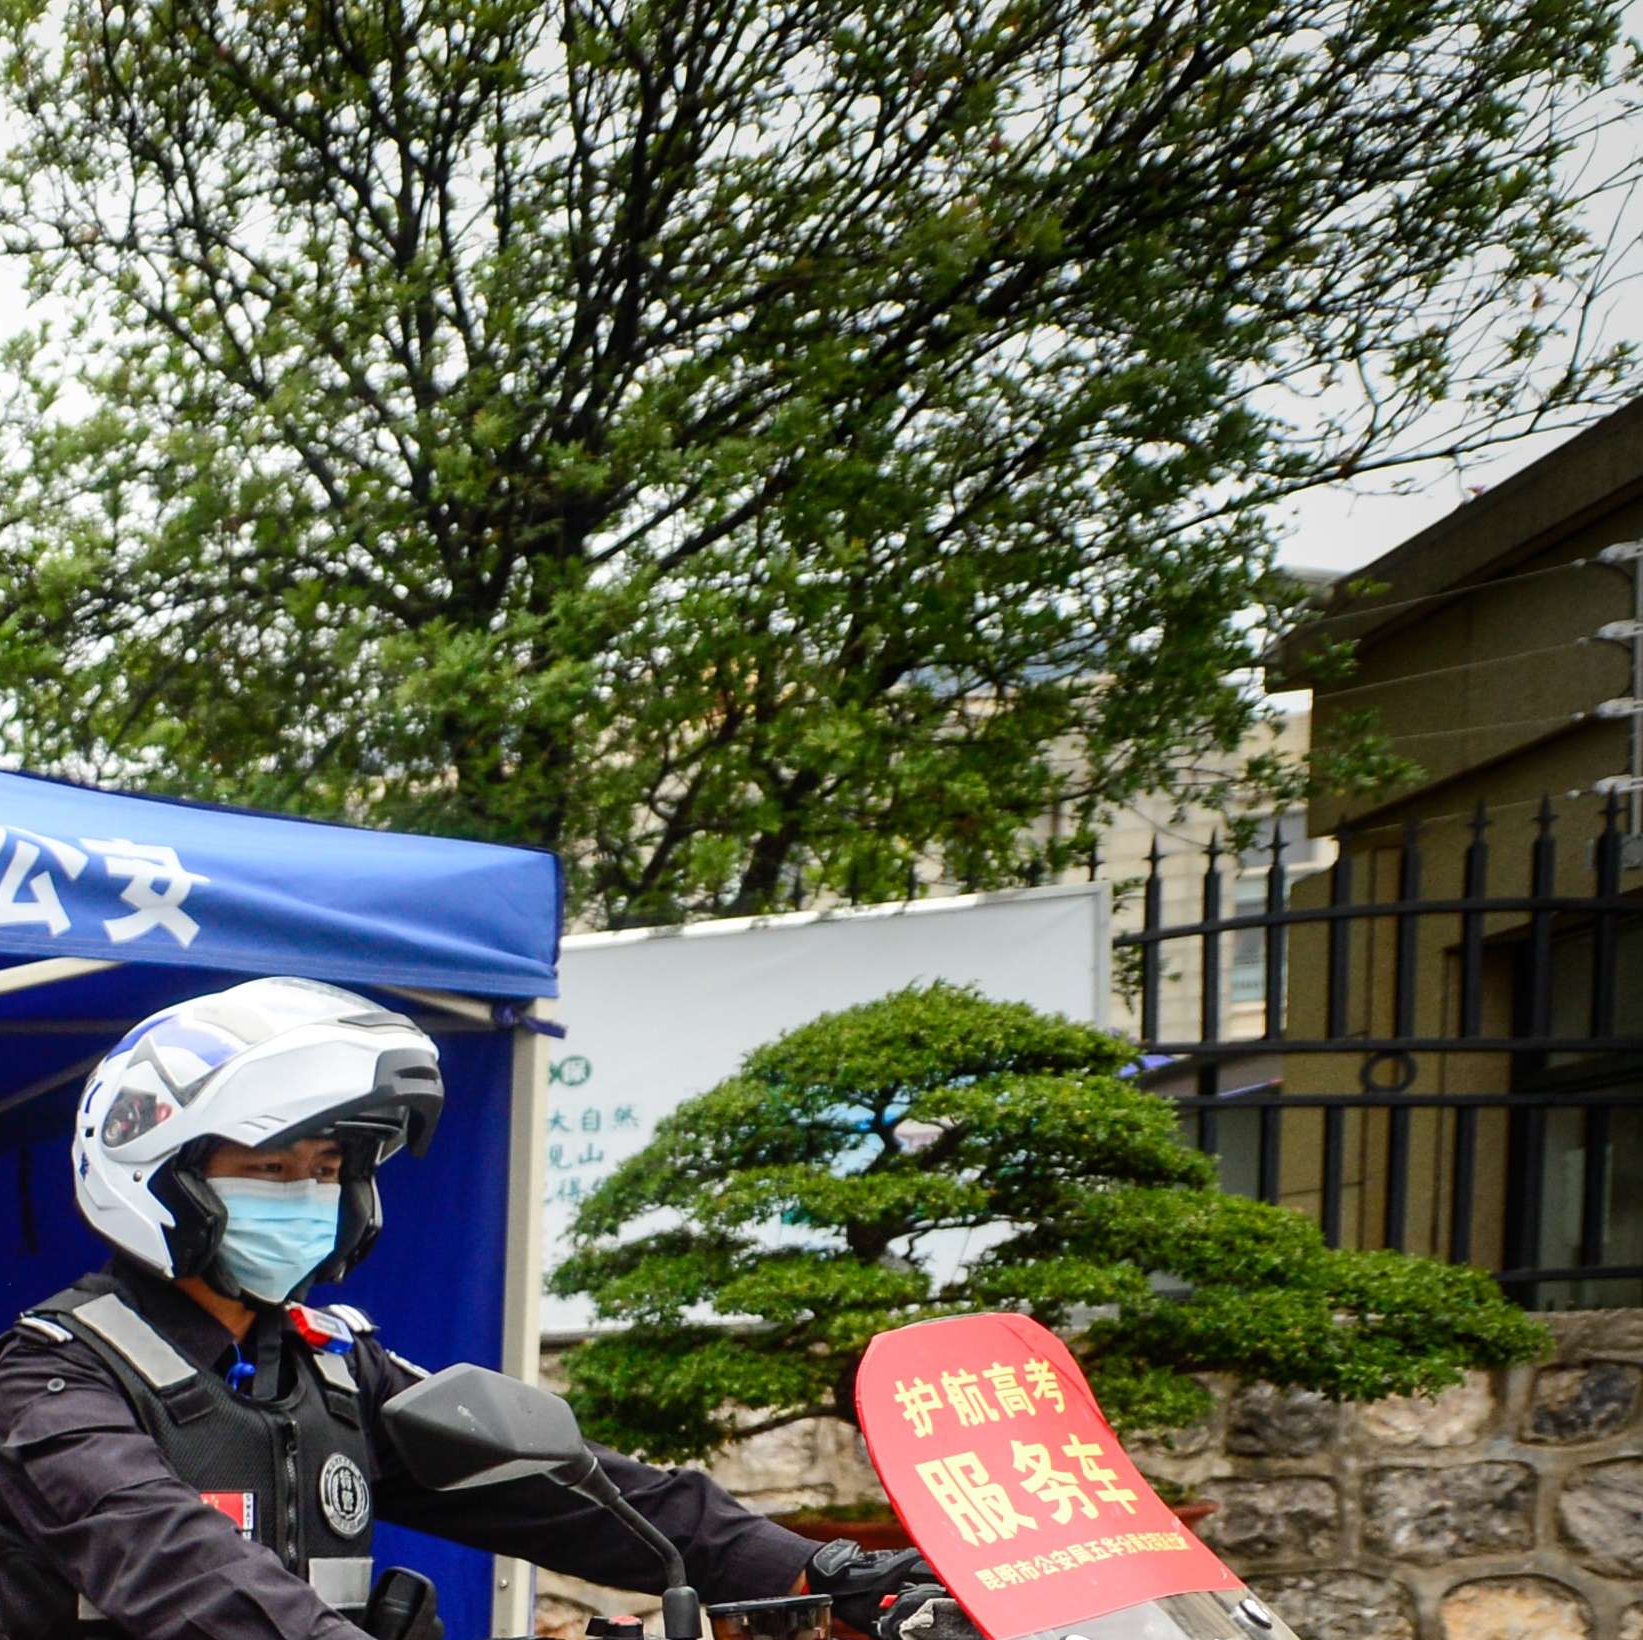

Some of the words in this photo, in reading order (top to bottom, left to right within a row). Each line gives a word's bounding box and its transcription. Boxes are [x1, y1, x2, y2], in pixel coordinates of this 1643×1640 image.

[894, 1358, 1065, 1438] 护航高考
[916, 1433, 1138, 1547] 服务车
